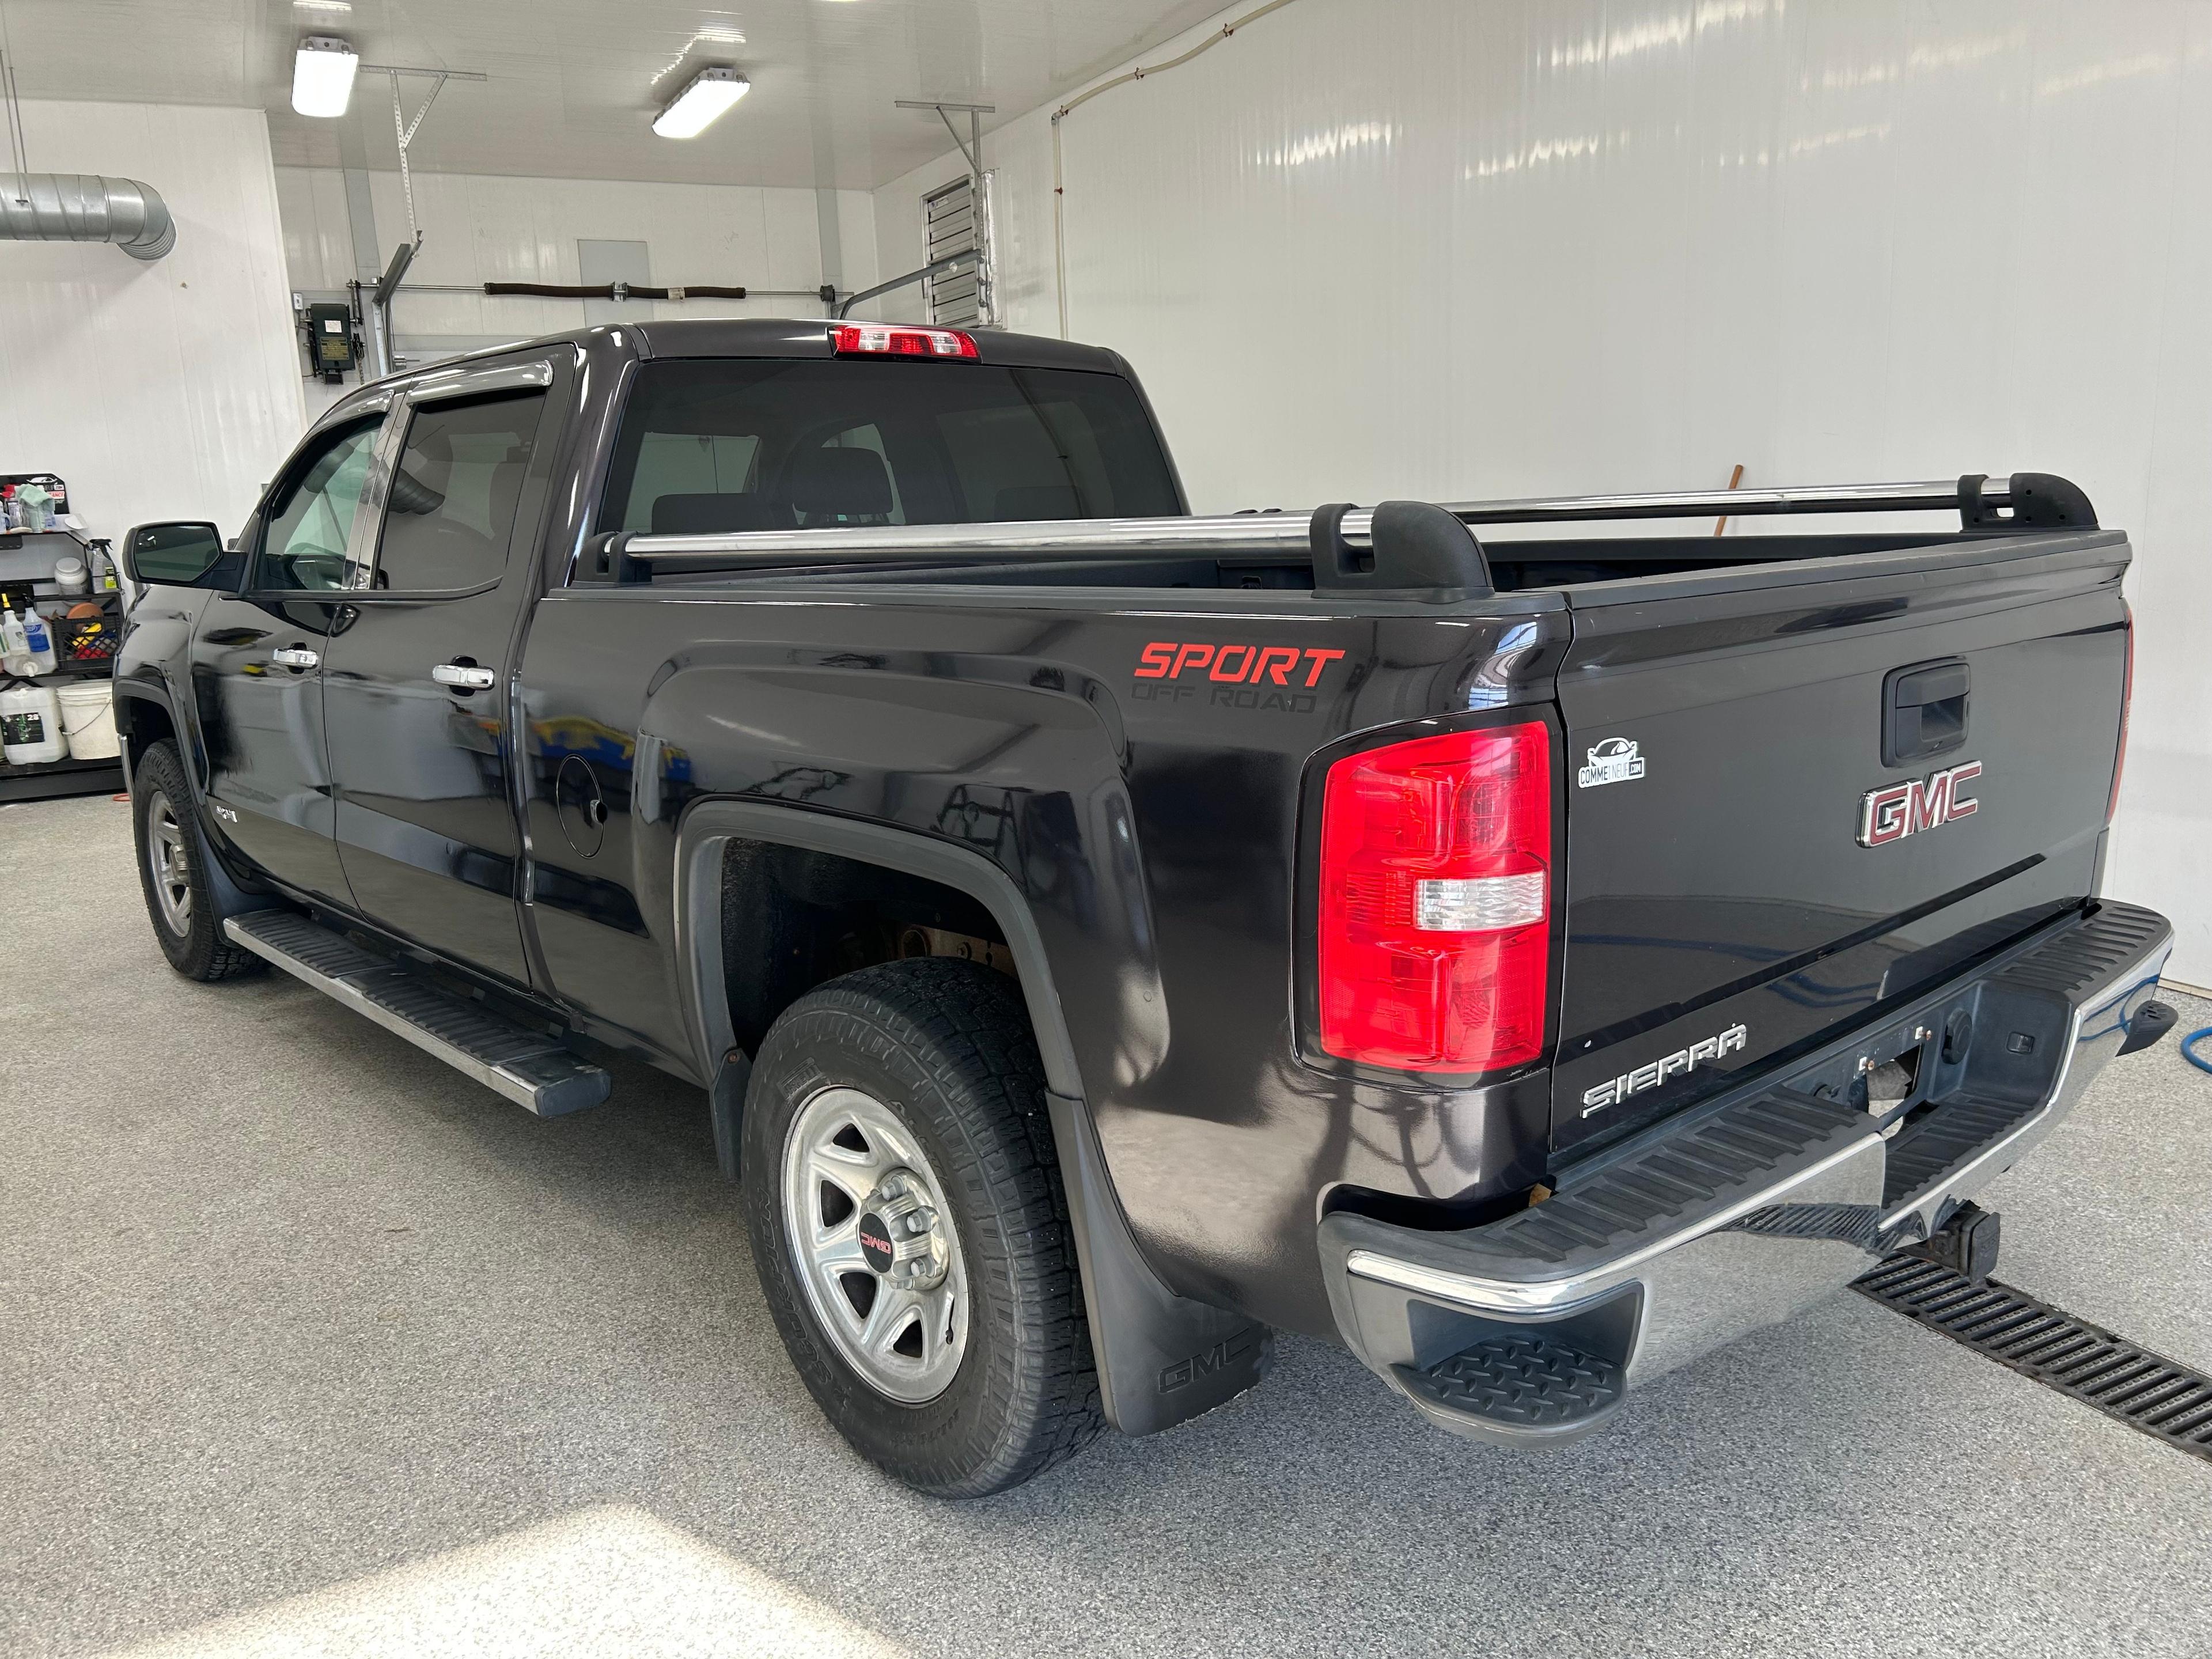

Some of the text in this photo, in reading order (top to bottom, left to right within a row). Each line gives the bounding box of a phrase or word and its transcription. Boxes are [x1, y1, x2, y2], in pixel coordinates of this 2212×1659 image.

[1134, 642, 1346, 687] SPORT
[1131, 683, 1317, 714] OFF ROAD
[1855, 760, 1982, 848] GMC
[1580, 1024, 1747, 1118] SIERRA
[861, 1232, 892, 1254] GMC
[756, 1186, 833, 1384] SCORPION
[1158, 1327, 1251, 1393] GMC
